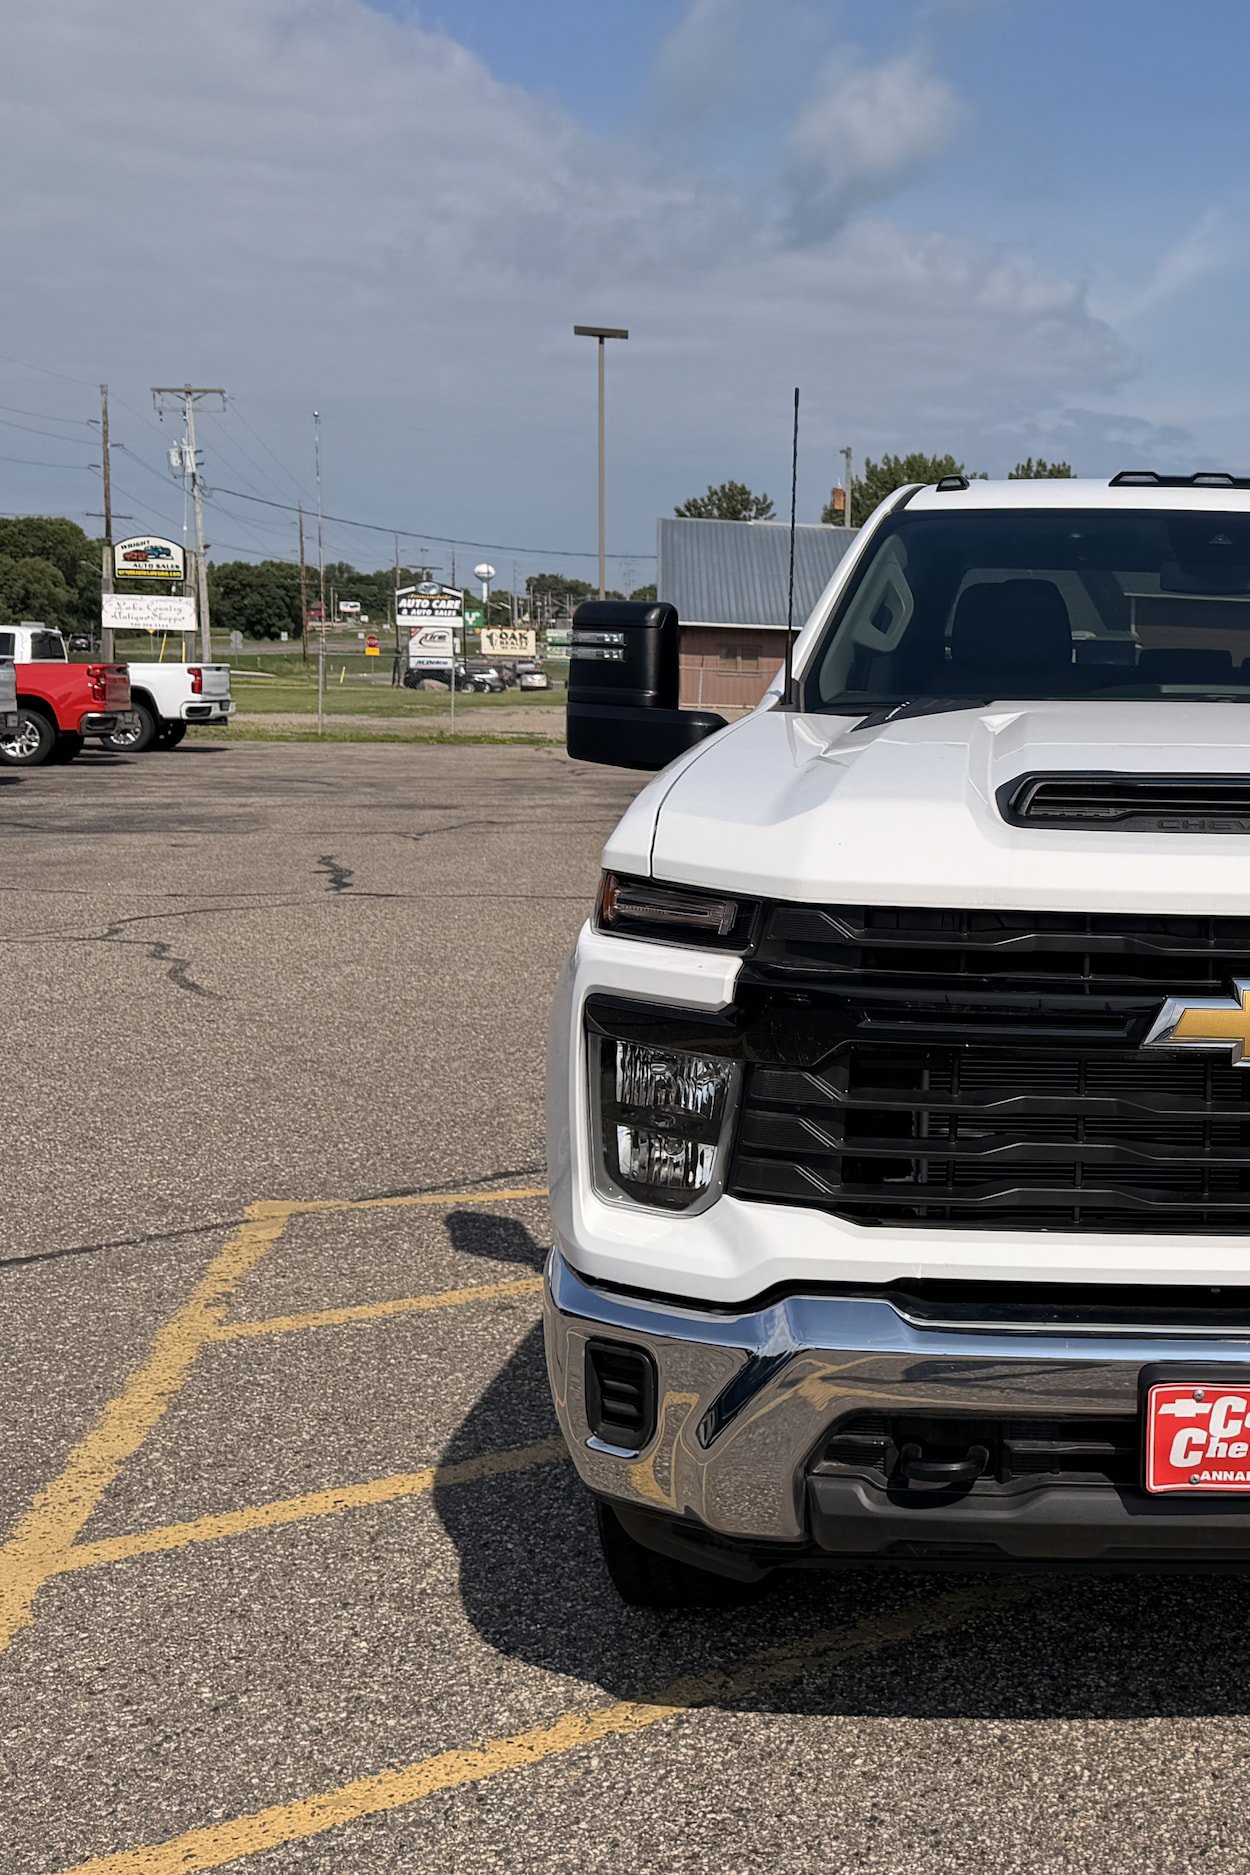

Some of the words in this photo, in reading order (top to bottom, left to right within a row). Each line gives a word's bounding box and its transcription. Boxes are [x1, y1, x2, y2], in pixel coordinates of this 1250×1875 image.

[121, 540, 150, 550] WRIGHT
[147, 601, 182, 615] Country
[398, 598, 430, 609] AUTO
[432, 599, 461, 610] CARE
[411, 608, 433, 616] AUTO
[499, 631, 528, 641] OAK
